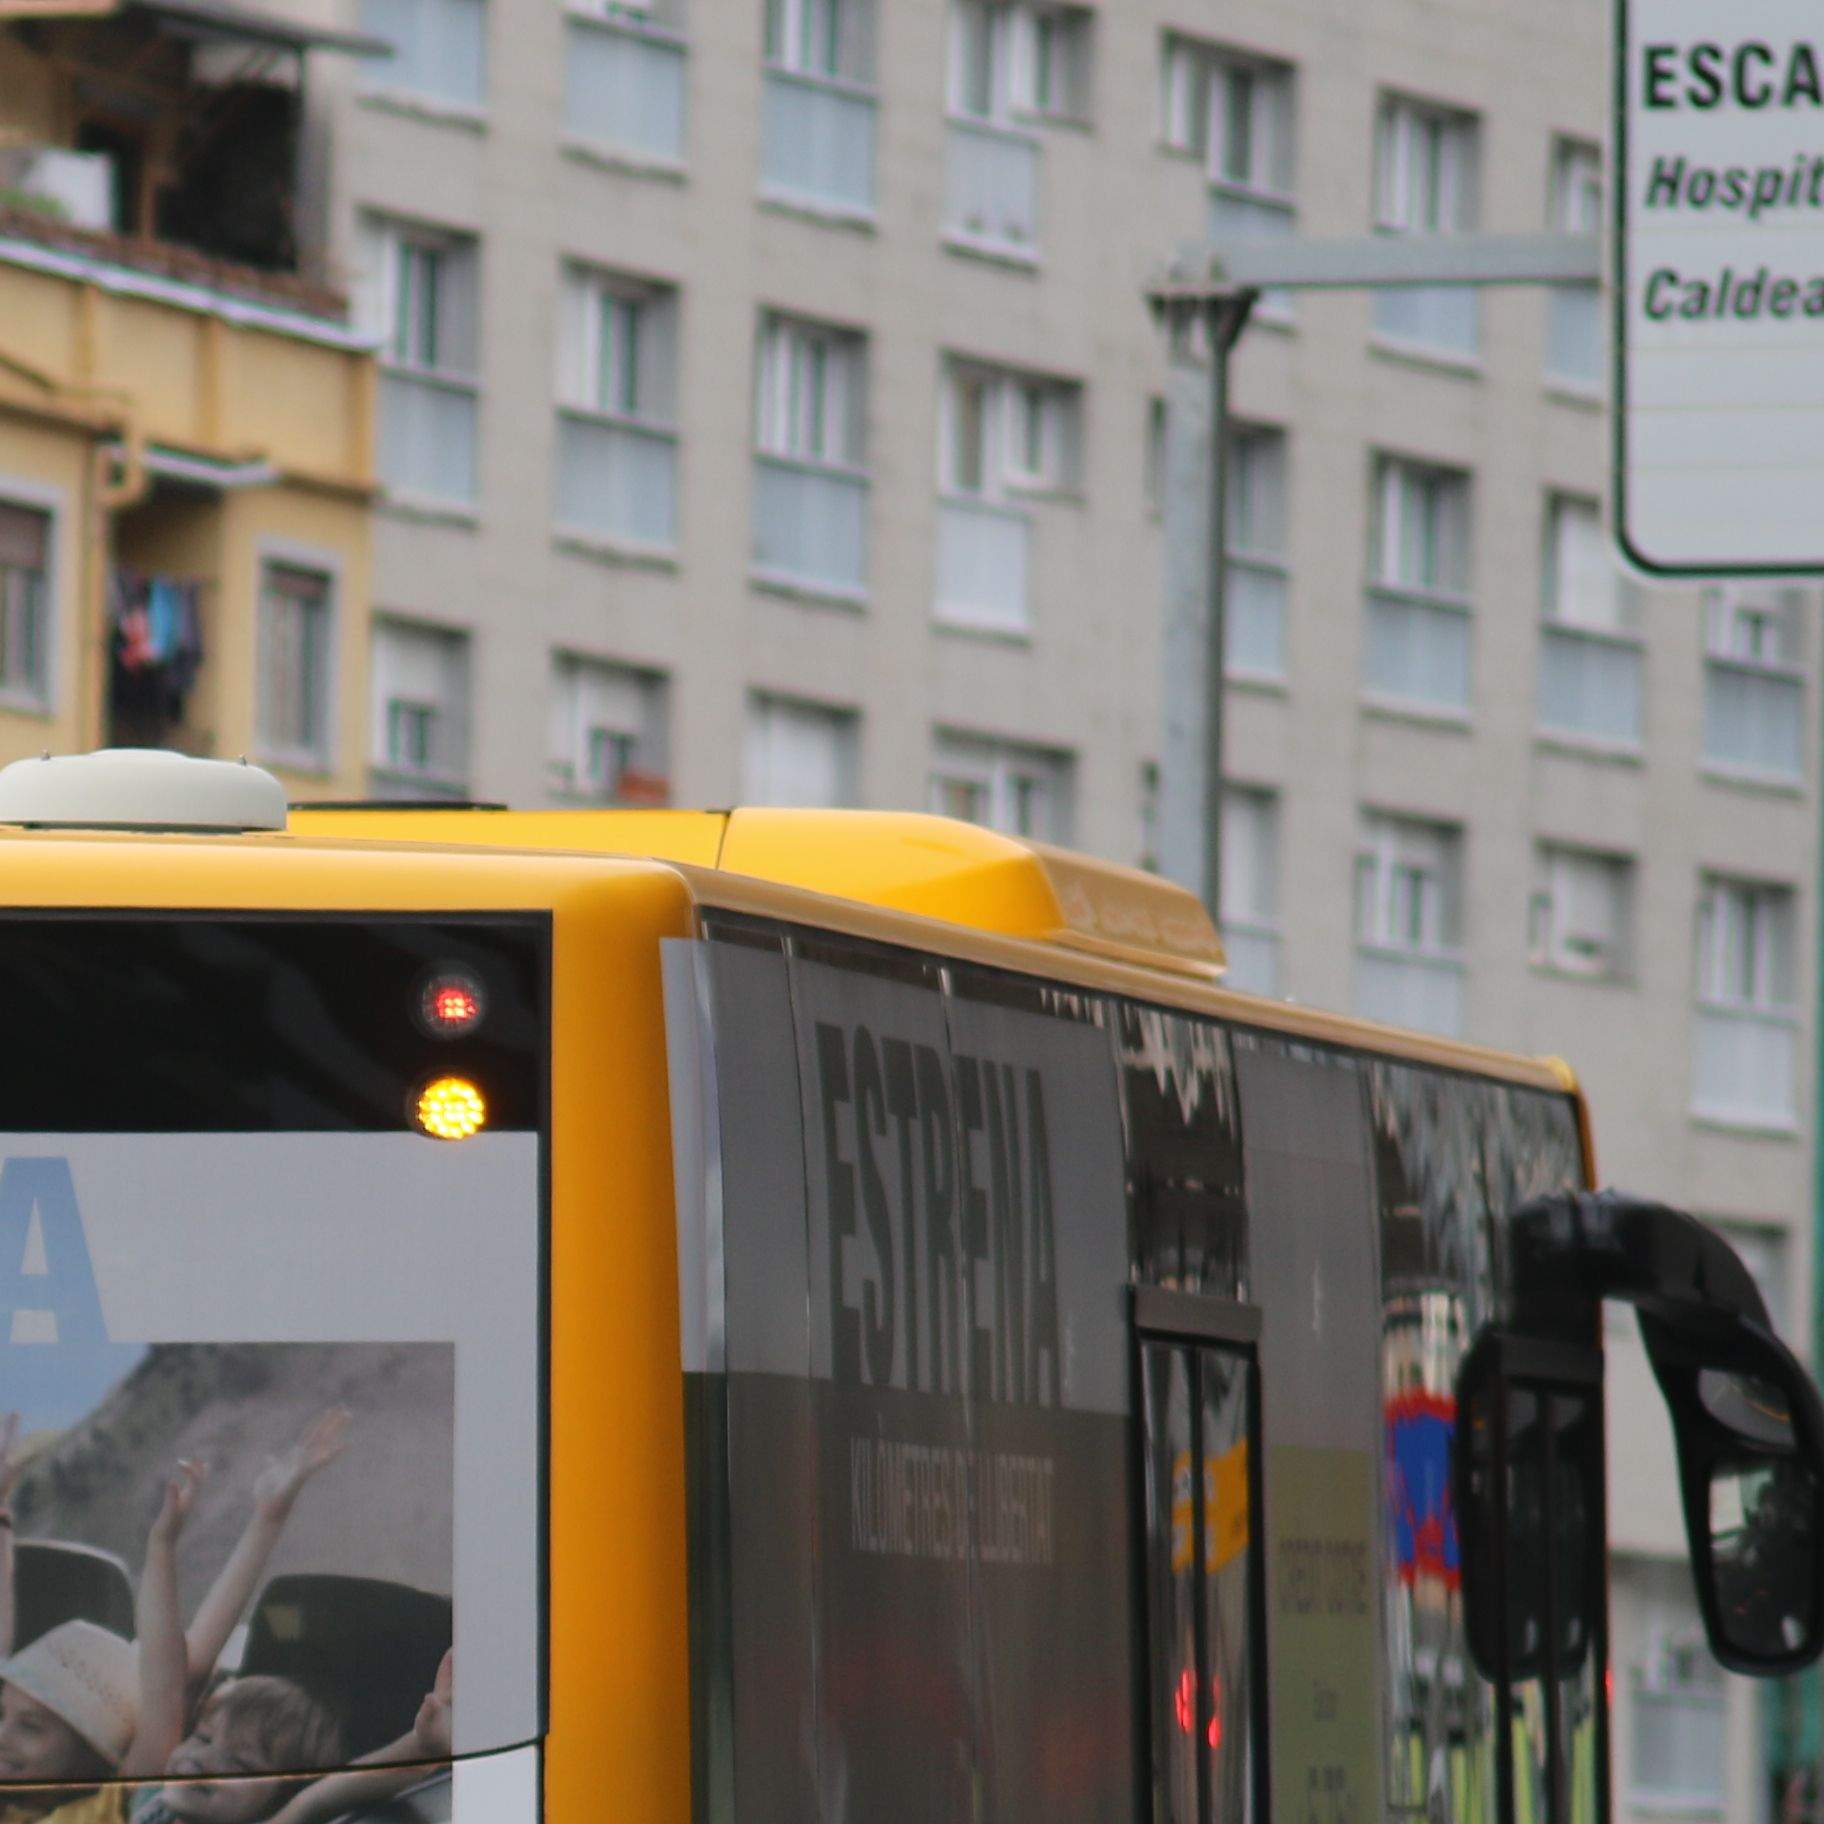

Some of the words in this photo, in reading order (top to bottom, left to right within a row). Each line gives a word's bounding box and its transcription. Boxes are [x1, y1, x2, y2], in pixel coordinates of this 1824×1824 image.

[1643, 41, 1824, 110] ESCA
[1645, 152, 1824, 220] Hospit
[1644, 266, 1824, 321] Caldea
[815, 1021, 1061, 1406] ESTRENA
